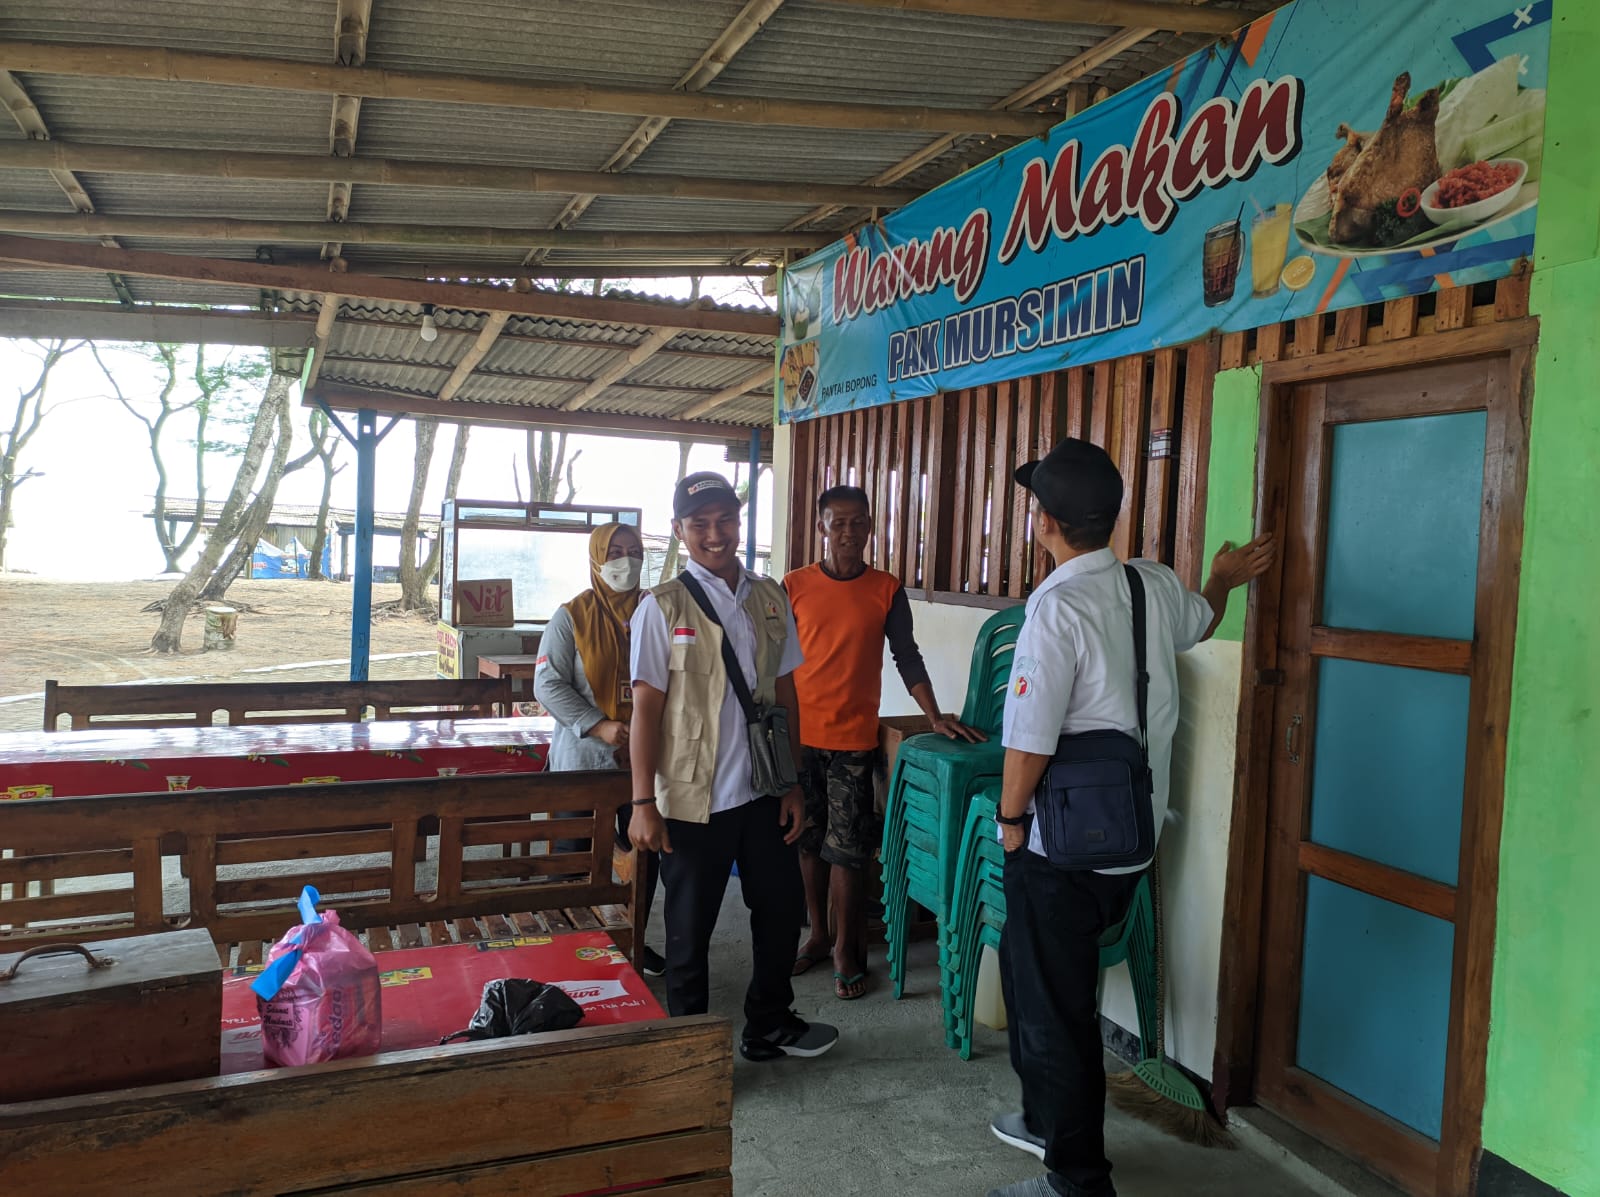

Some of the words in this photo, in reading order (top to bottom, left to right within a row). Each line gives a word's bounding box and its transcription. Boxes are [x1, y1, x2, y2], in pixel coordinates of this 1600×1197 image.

[832, 206, 989, 326] Warung
[997, 74, 1305, 263] Makan
[887, 318, 941, 383] PAK
[942, 254, 1146, 371] MURSIMIN
[821, 381, 844, 403] PANTAI
[845, 373, 877, 393] BOPONG
[463, 585, 509, 612] Vit
